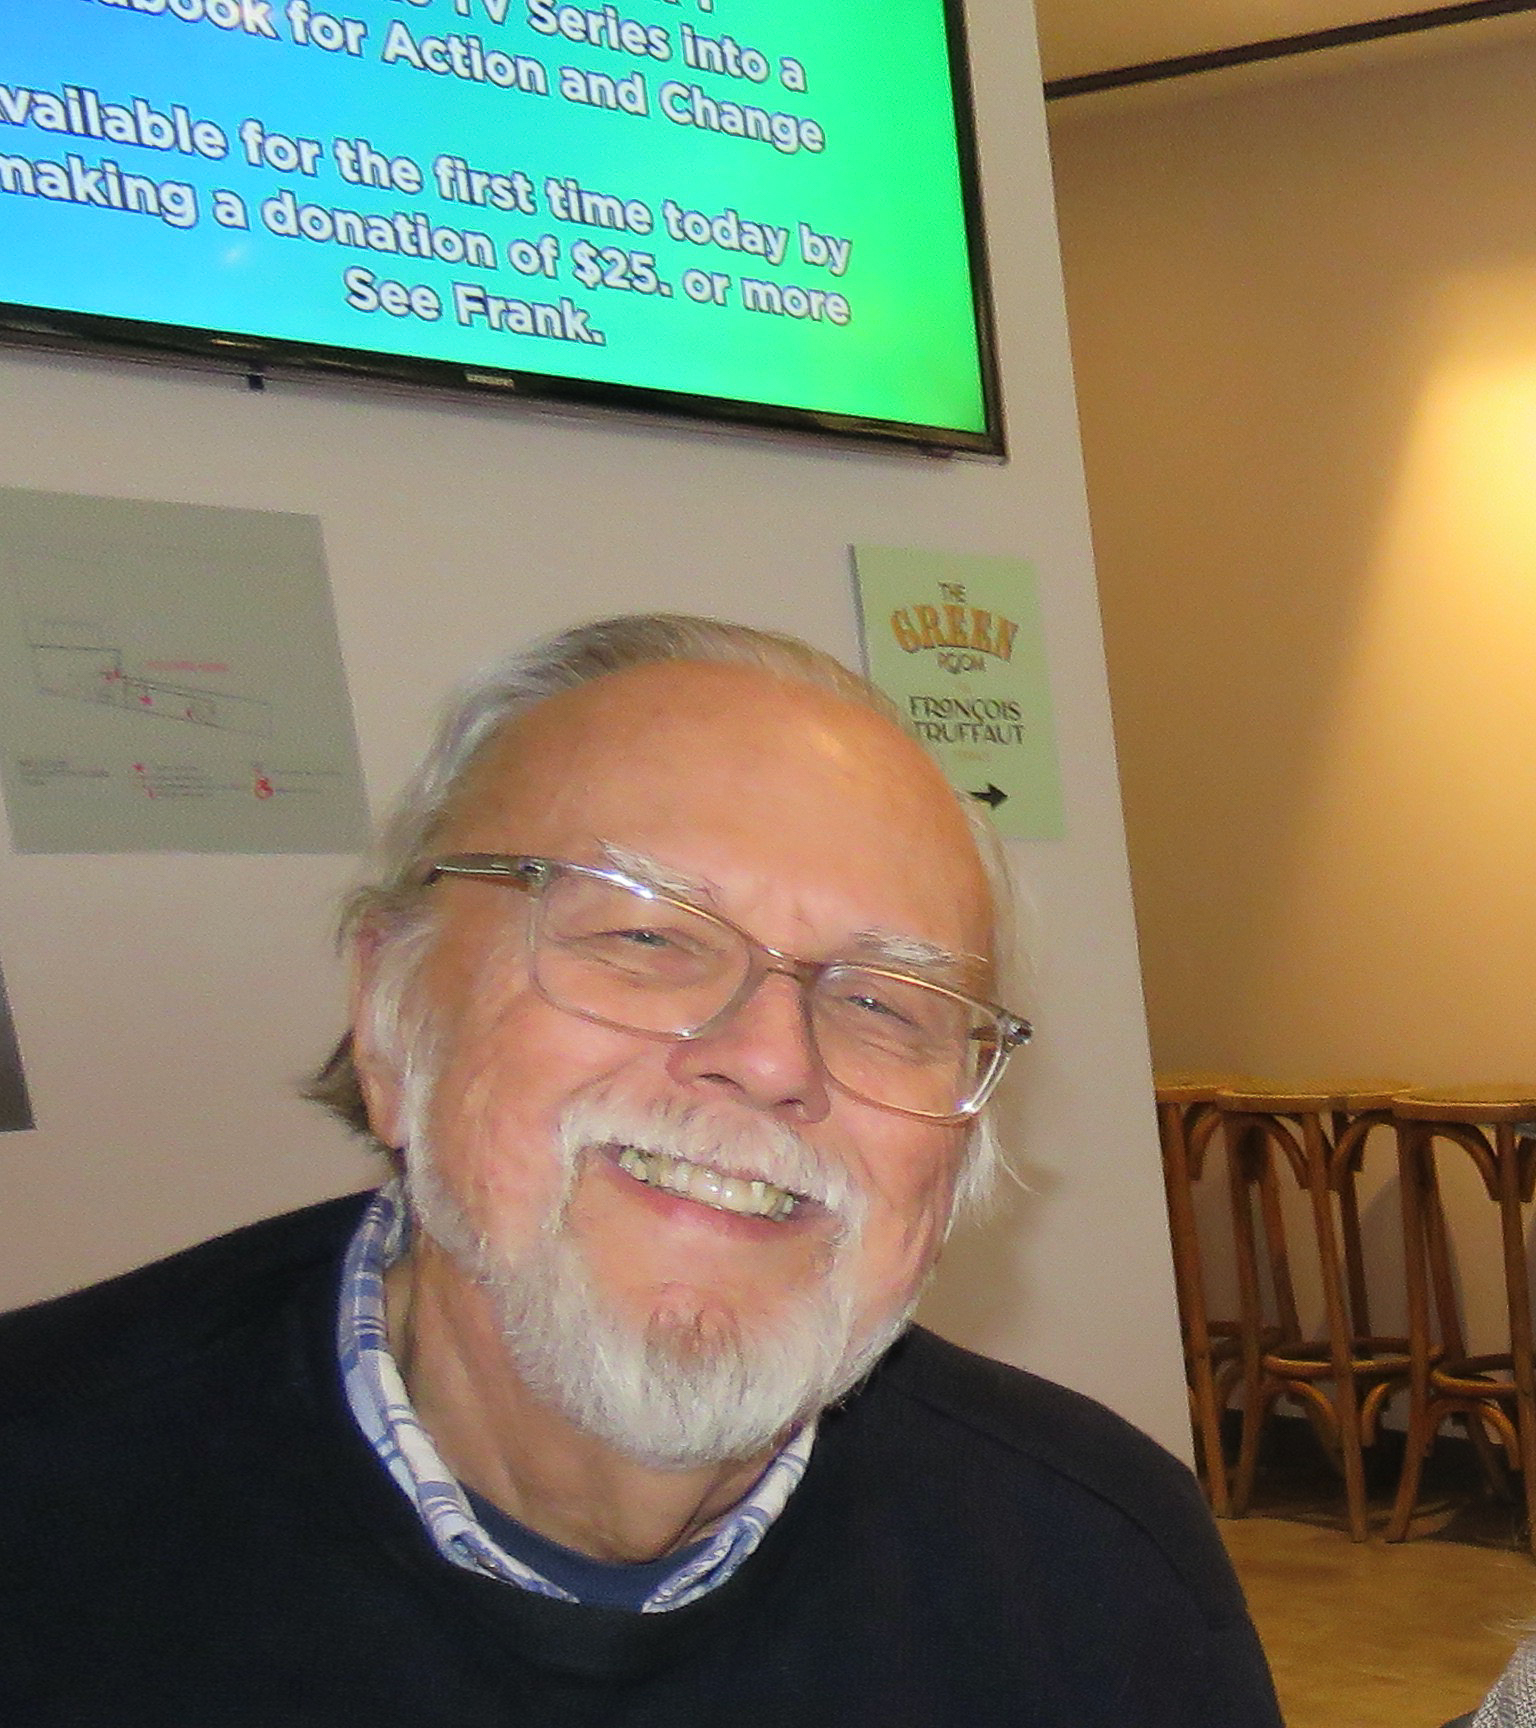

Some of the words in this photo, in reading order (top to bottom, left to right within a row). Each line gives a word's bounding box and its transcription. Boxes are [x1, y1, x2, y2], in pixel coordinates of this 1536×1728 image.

[285, 0, 369, 58] for
[380, 19, 550, 97] Action
[559, 66, 651, 118] and
[658, 80, 827, 155] Change
[526, 0, 673, 62] Series
[679, 22, 770, 84] into
[779, 56, 808, 94] a
[0, 83, 230, 161] vailable
[238, 117, 323, 178] for
[332, 137, 425, 195] the
[433, 154, 538, 216] first
[544, 176, 654, 235] time
[660, 198, 789, 266] today
[797, 221, 853, 277] by
[212, 189, 250, 231] a
[260, 188, 497, 270] donation
[507, 234, 560, 280] of
[571, 238, 673, 298] $25.
[683, 268, 733, 306] or
[739, 277, 853, 326] more
[343, 265, 443, 322] See
[452, 280, 607, 346] Frank.
[913, 720, 1024, 745] TRUFFAUT
